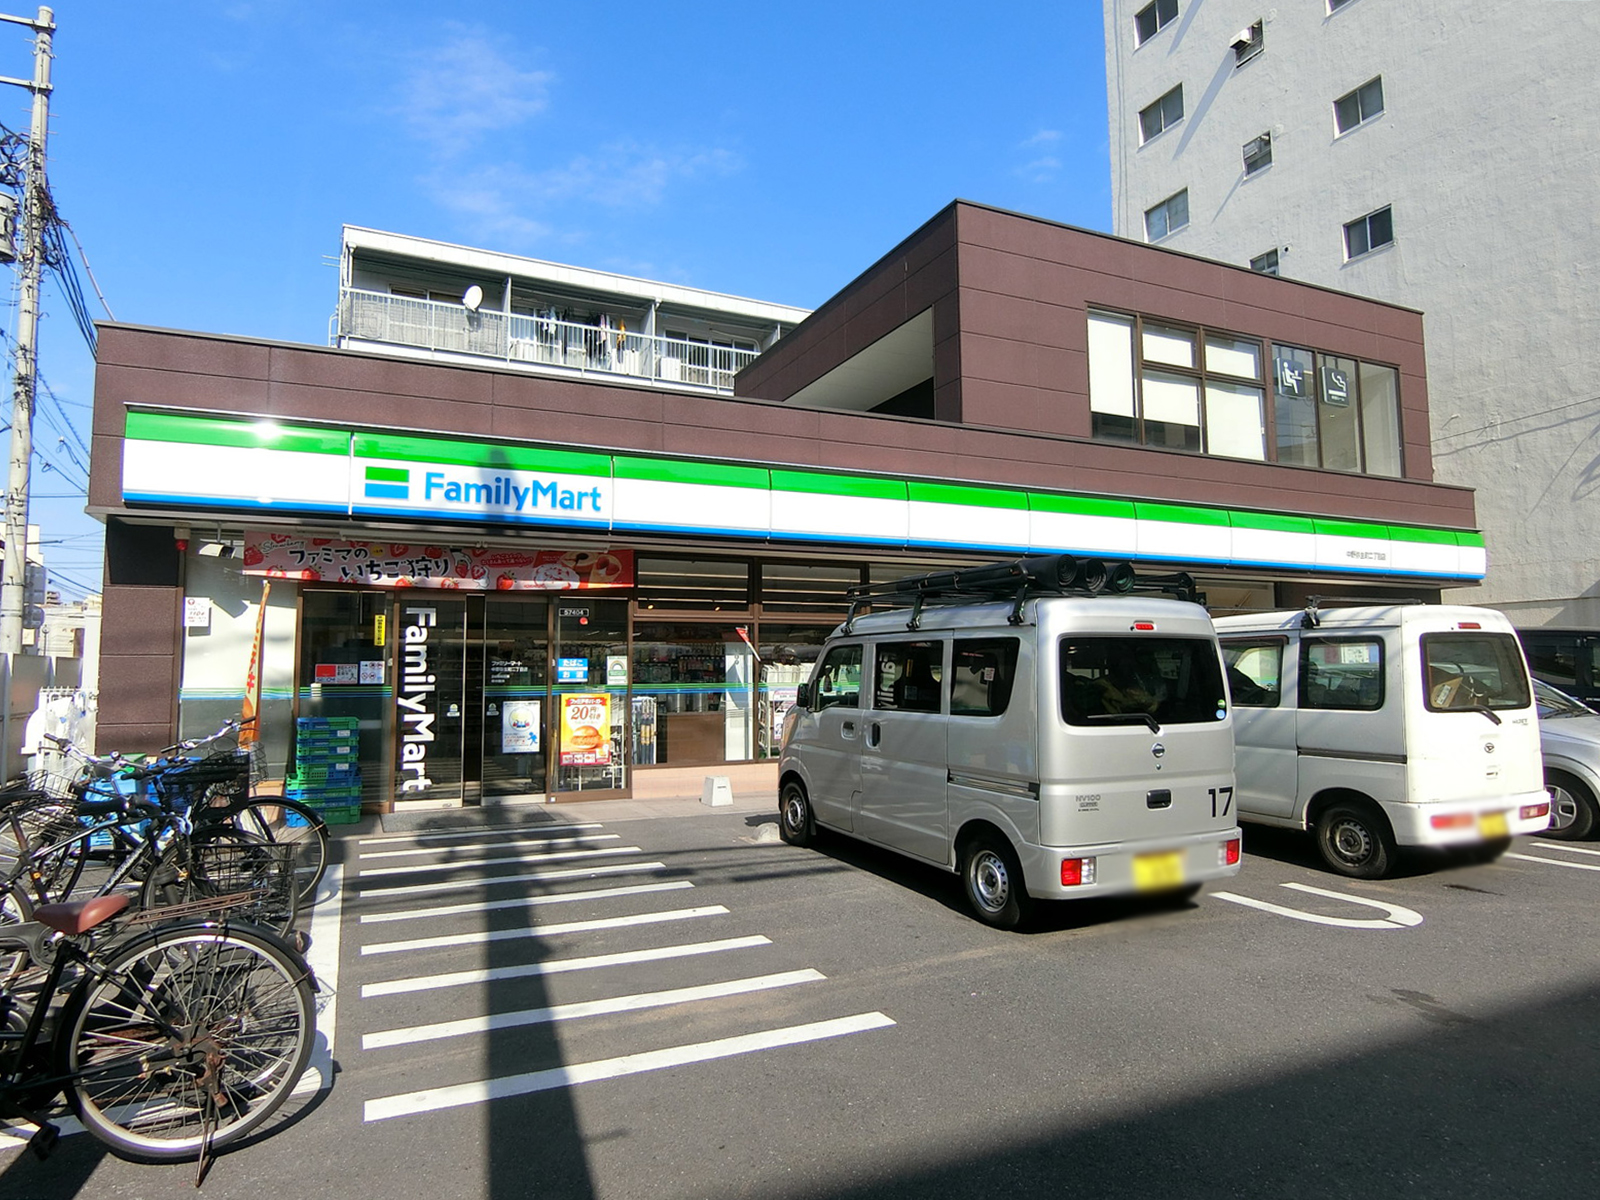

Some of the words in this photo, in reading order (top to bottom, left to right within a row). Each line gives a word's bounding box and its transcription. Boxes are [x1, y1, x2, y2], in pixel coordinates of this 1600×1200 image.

[425, 471, 602, 511] FamilyMart
[289, 547, 369, 564] ファミマの
[341, 556, 449, 581] いちご狩り
[562, 659, 584, 667] たばこ
[397, 607, 437, 791] FamilyMart
[1075, 793, 1101, 802] NV100
[1208, 786, 1233, 817] 17
